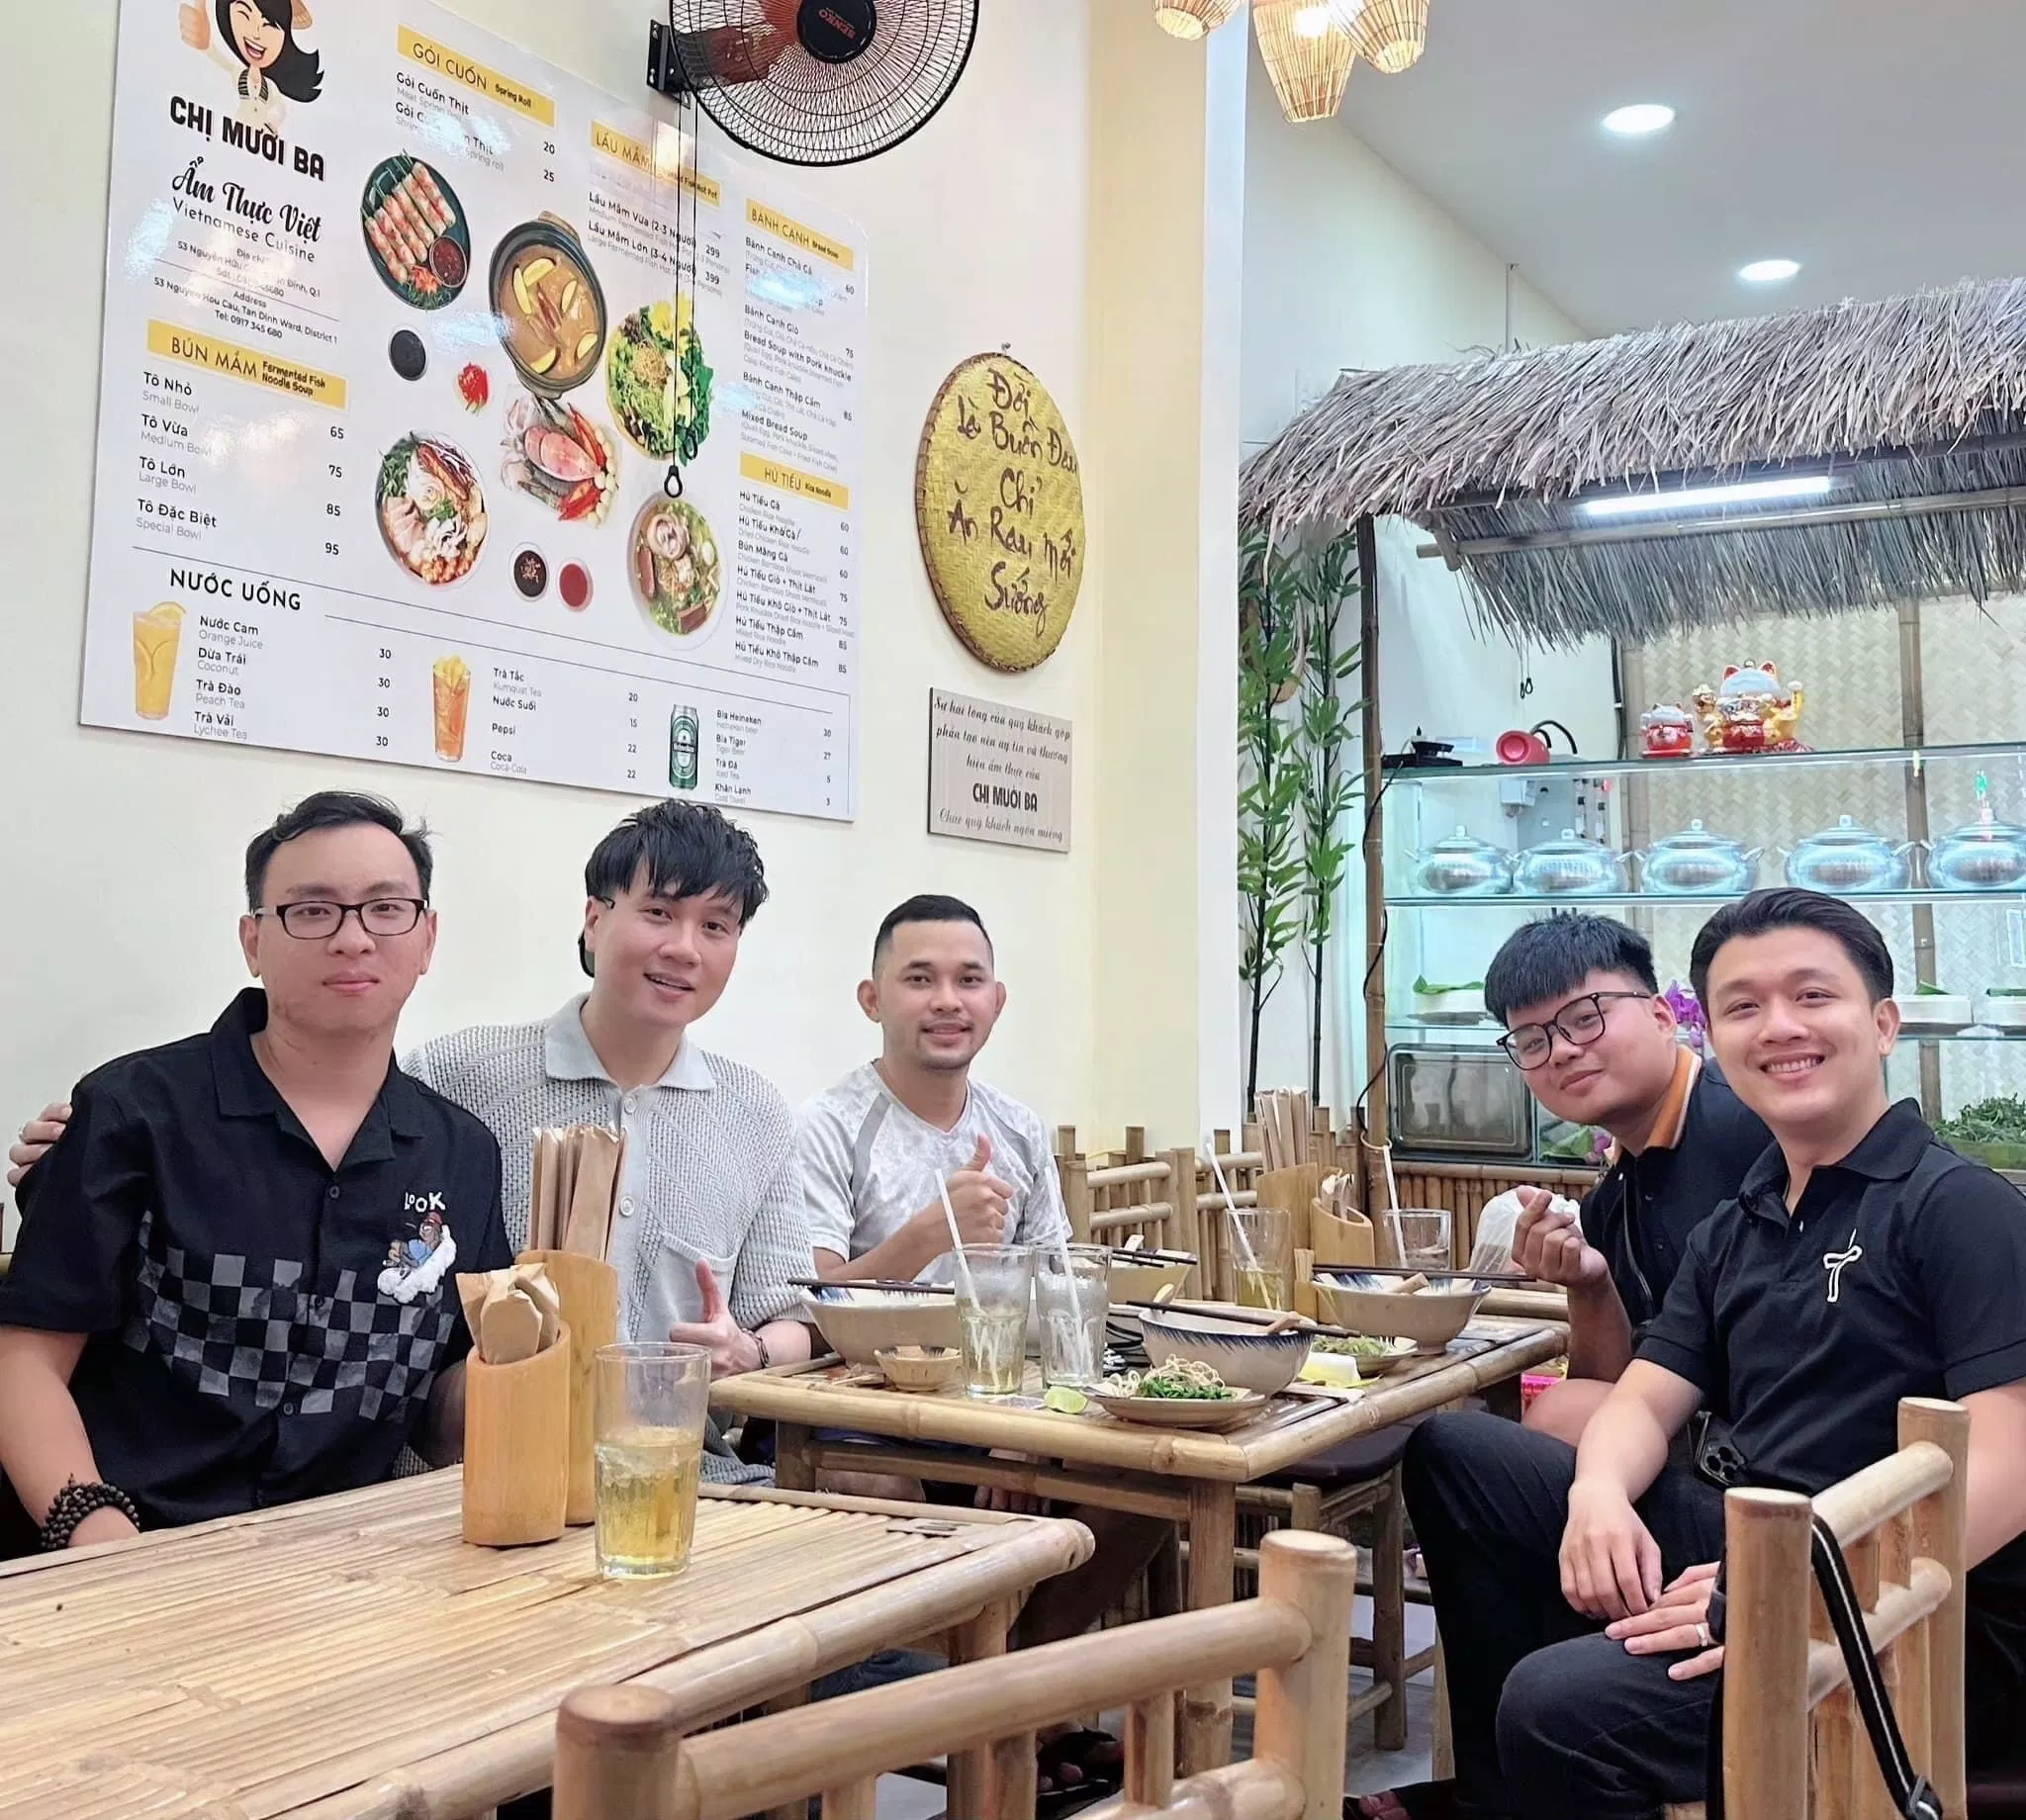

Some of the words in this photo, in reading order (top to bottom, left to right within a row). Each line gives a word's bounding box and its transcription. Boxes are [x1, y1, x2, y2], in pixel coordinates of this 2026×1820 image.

[397, 72, 414, 88] Gỏi
[418, 82, 445, 101] Cuốn
[448, 96, 469, 115] Thịt
[494, 82, 517, 103] Spring
[518, 94, 531, 109] Roll
[170, 96, 213, 141] CHỊ
[223, 116, 284, 165] MƯỜI
[294, 145, 324, 181] BA
[544, 141, 555, 154] 20
[544, 170, 555, 182] 25
[172, 156, 215, 203] Ẩm
[223, 182, 272, 224] Thực
[279, 204, 322, 244] Việt
[173, 196, 258, 242] Vietnamese
[265, 232, 315, 263] Cuisine
[783, 225, 809, 246] CANH
[178, 241, 188, 251] 53
[705, 244, 720, 258] 299
[767, 247, 785, 262] Canh
[705, 271, 719, 285] 399
[846, 285, 854, 295] 60
[233, 291, 267, 308] Address
[153, 276, 165, 287] 53
[259, 311, 278, 324] Dinh
[305, 325, 332, 342] District
[230, 316, 248, 330] 0917
[251, 322, 265, 333] 345
[267, 327, 283, 339] 680
[745, 330, 767, 347] Bread
[846, 348, 854, 358] 75
[171, 336, 208, 363] BÚN
[262, 361, 307, 384] Fermented
[310, 374, 325, 389] Fish
[143, 371, 159, 387] Tô
[164, 379, 192, 396] Nhỏ
[262, 373, 291, 390] Noodle
[293, 382, 314, 397] Soup
[142, 391, 171, 407] Small
[174, 399, 199, 413] Bowl
[141, 413, 157, 428] Tô
[162, 419, 188, 437] Vừa
[330, 426, 344, 439] 65
[742, 410, 764, 425] Mixed
[790, 427, 808, 441] Soup
[140, 431, 184, 451] Medium
[990, 411, 1042, 459] Buồn
[139, 456, 155, 470] Tô
[160, 462, 186, 479] Lớn
[328, 465, 342, 478] 75
[138, 472, 168, 488] Large
[171, 480, 196, 494] Bowl
[138, 499, 153, 512] Tô
[158, 503, 185, 522] Đặc
[190, 511, 218, 528] Biệt
[326, 503, 340, 516] 85
[841, 522, 849, 532] 60
[947, 480, 978, 543] Ăn
[990, 505, 1033, 558] Rau
[137, 517, 173, 534] Special
[177, 525, 202, 539] Bowl
[324, 543, 339, 555] 95
[840, 546, 849, 556] 60
[840, 570, 848, 579] 60
[170, 568, 232, 597] NƯỚC
[241, 582, 301, 611] UỐNG
[840, 593, 848, 603] 75
[200, 615, 230, 630] Nước
[233, 621, 259, 636] Cam
[840, 617, 847, 626] 75
[199, 630, 235, 645] Orange
[237, 636, 263, 649] Juice
[198, 647, 221, 662] Dừa
[226, 652, 246, 665] Trái
[379, 649, 392, 659] 30
[198, 661, 238, 676] Coconut
[494, 668, 507, 680] Trà
[196, 679, 215, 691] Trà
[218, 682, 241, 695] Đào
[378, 679, 391, 688] 30
[196, 692, 227, 706] Peach
[229, 698, 245, 709] Tea
[493, 695, 515, 708] Nước
[517, 699, 536, 711] Suối
[628, 692, 638, 702] 20
[195, 711, 213, 724] Trà
[217, 713, 234, 726] Vải
[377, 707, 389, 717] 30
[717, 709, 728, 720] Bia
[730, 712, 762, 725] Heineken
[492, 723, 516, 736] Pepsi
[630, 718, 637, 728] 15
[193, 724, 229, 739] Lychee
[230, 729, 247, 740] Tea
[716, 734, 727, 744] Bia
[376, 736, 389, 746] 30
[627, 744, 637, 753] 22
[491, 751, 512, 763] Coca
[626, 770, 636, 778] 22
[973, 783, 989, 809] CHỊ
[1024, 792, 1037, 811] BA
[405, 1192, 446, 1213] LOOK
